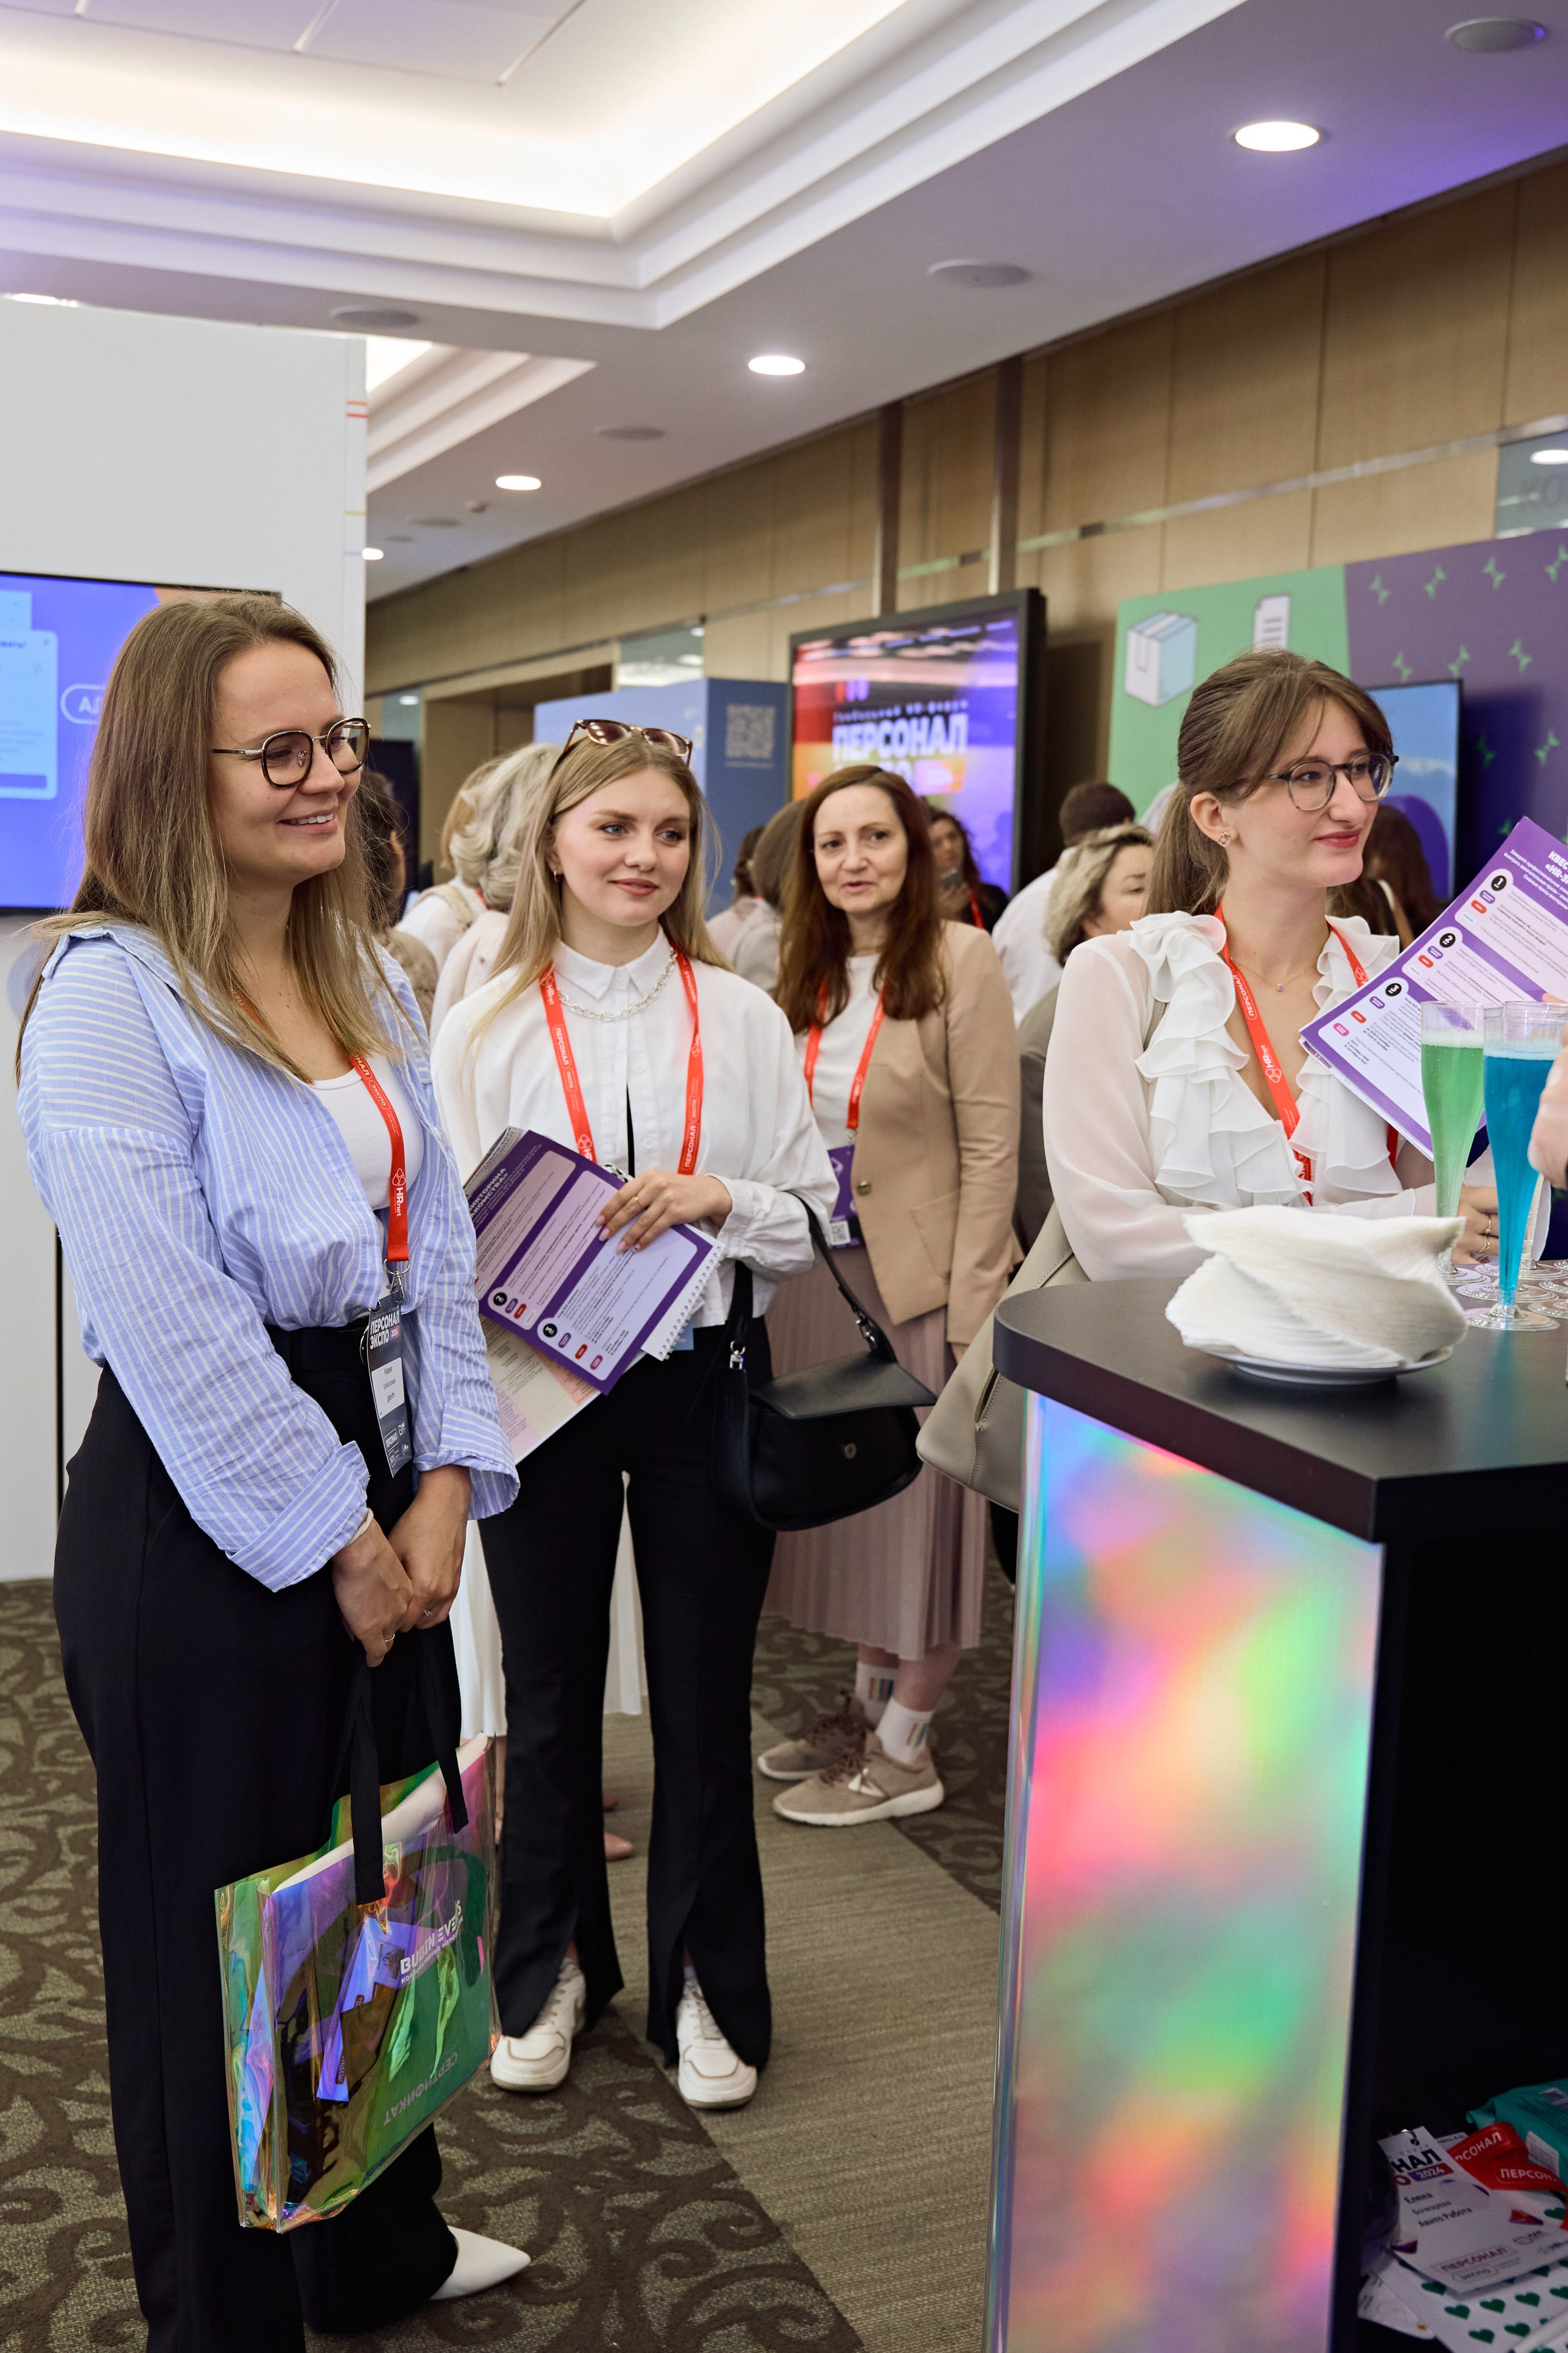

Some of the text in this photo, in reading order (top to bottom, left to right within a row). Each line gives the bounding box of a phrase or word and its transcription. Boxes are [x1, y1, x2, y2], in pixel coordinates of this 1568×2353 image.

[832, 713, 969, 761] ПЕРСОНАЛ
[1548, 851, 1568, 871] КВЕС
[1444, 934, 1453, 943] 2
[1232, 975, 1254, 1017] ПЕРСОНАЛ
[1390, 984, 1399, 992] 3
[555, 1027, 569, 1065] ПЕРСОНАЛ
[1262, 1044, 1273, 1068] HRnet
[371, 1084, 386, 1106] ЭКСПО
[684, 1125, 696, 1168] ПЕРСОНАЛ
[370, 1310, 400, 1335] ПЕРСОНАЛ
[370, 1328, 390, 1350] ЭКСПО
[400, 1932, 435, 1975] BUBIN
[383, 2052, 458, 2126] СЕРТИФИКАТ
[1416, 2167, 1446, 2178] 2024
[1441, 2248, 1509, 2272] ПЕРСОНАЛ
